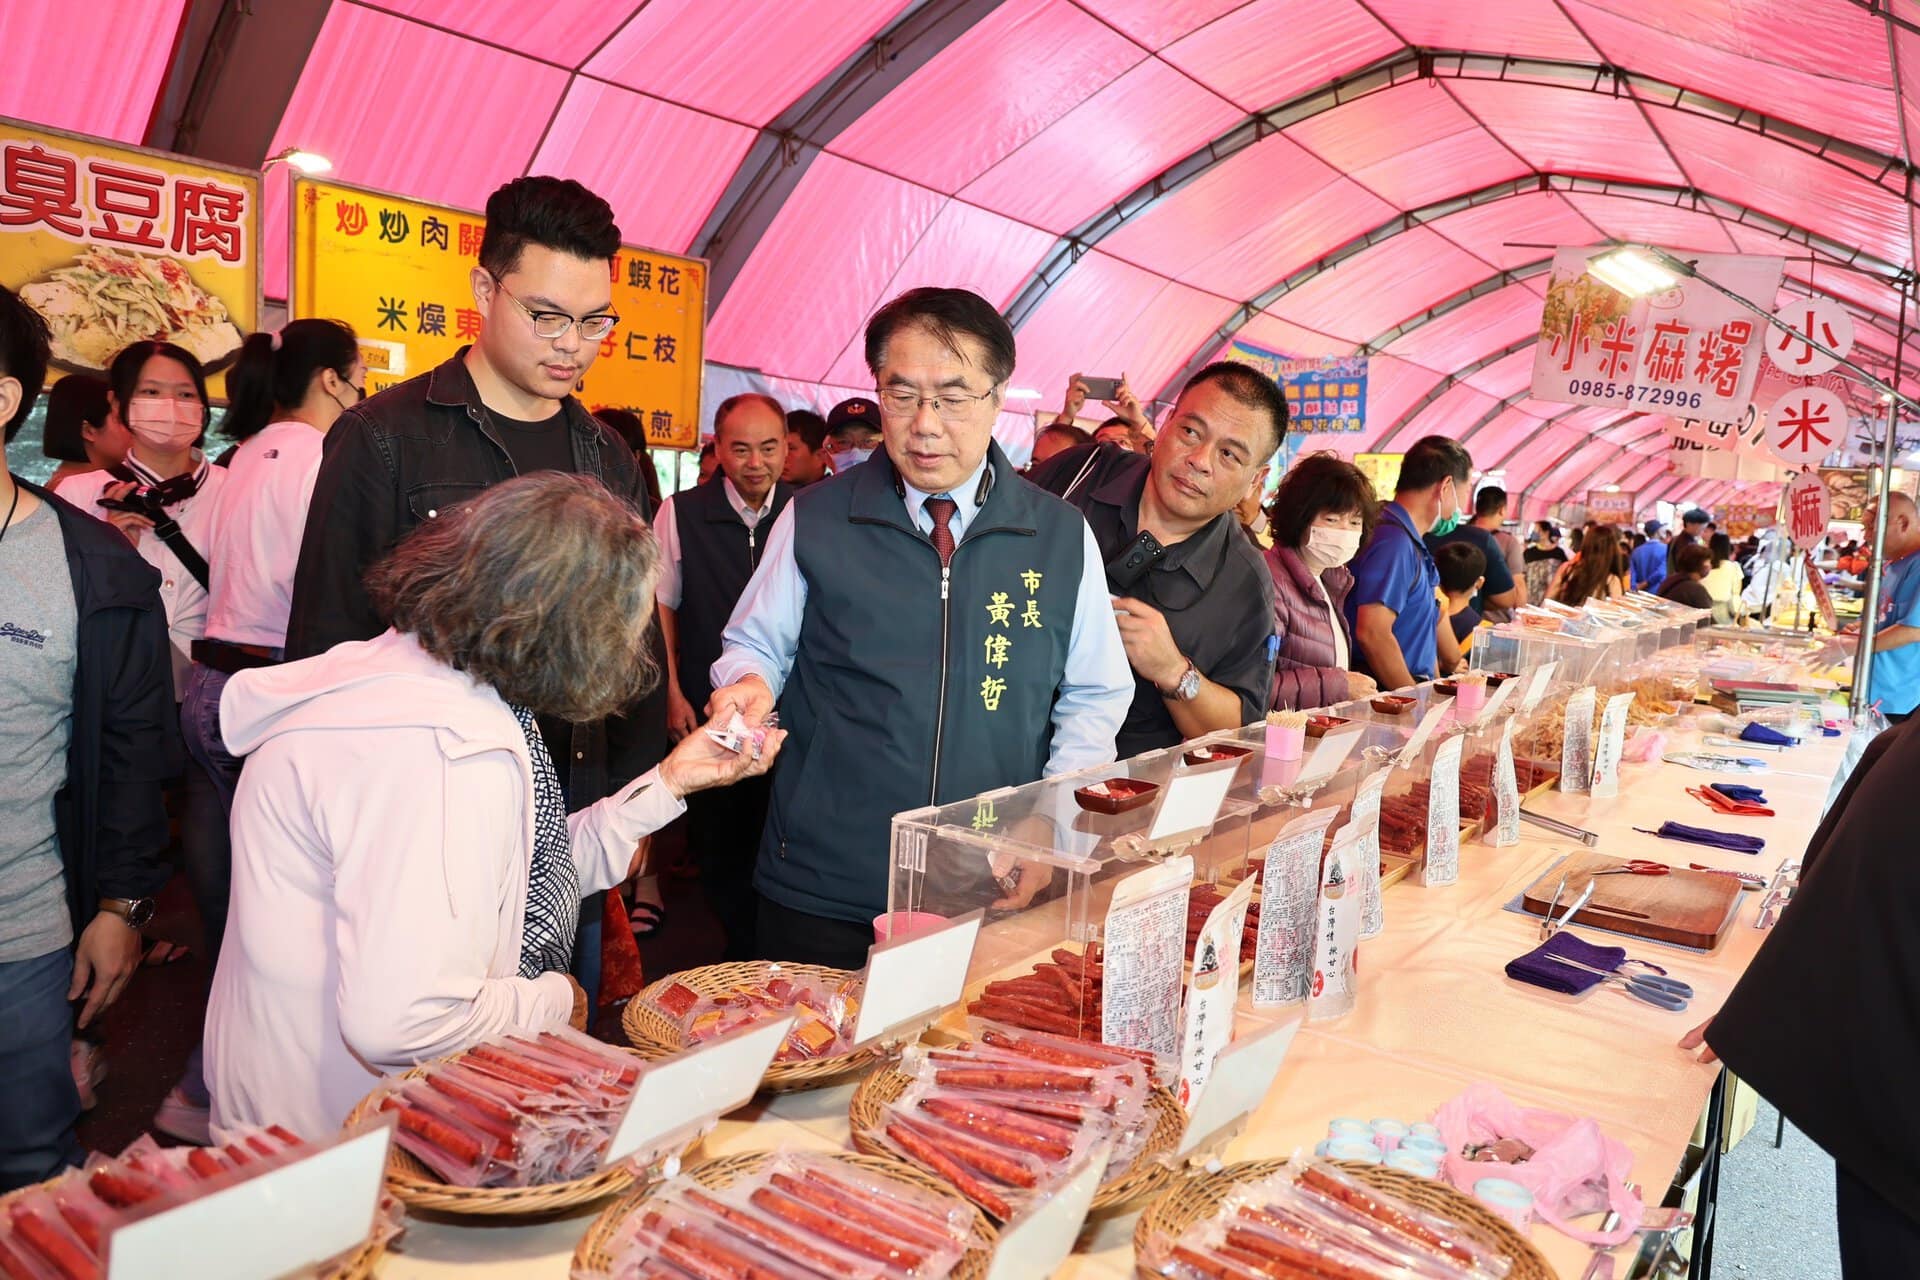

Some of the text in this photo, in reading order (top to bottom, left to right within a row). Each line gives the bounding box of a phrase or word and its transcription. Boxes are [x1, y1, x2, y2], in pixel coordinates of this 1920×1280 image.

[0, 145, 244, 262] 臭豆腐
[1549, 313, 1753, 397] 小米麻糬
[1568, 378, 1702, 409] 0985-872996
[1020, 568, 1043, 628] 市長
[980, 591, 1016, 711] 黃偉哲
